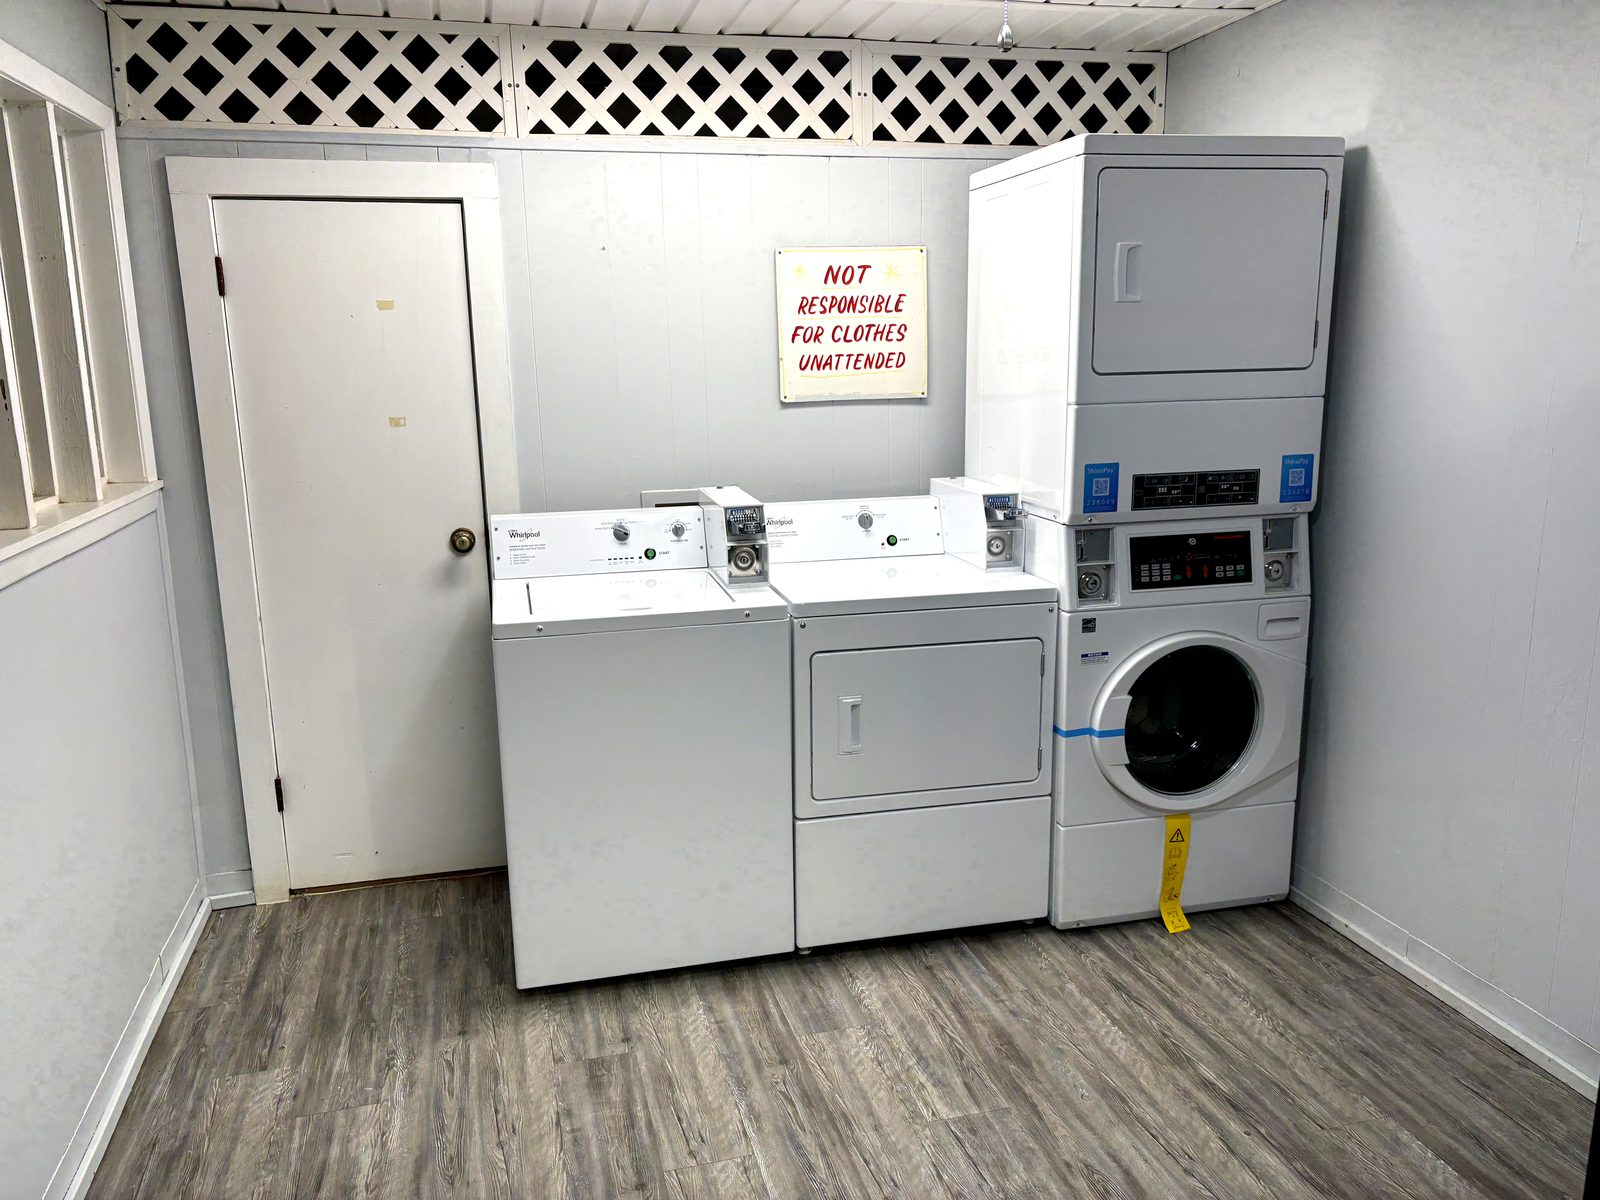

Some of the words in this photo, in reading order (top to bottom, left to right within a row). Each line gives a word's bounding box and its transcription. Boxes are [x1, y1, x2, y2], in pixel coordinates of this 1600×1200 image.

[823, 265, 872, 286] NOT
[797, 293, 907, 315] RESPONSIBLE
[791, 325, 825, 344] FOR
[831, 323, 908, 344] CLOTHES
[798, 351, 906, 372] UNATTENDED
[508, 530, 541, 540] Whirlpool
